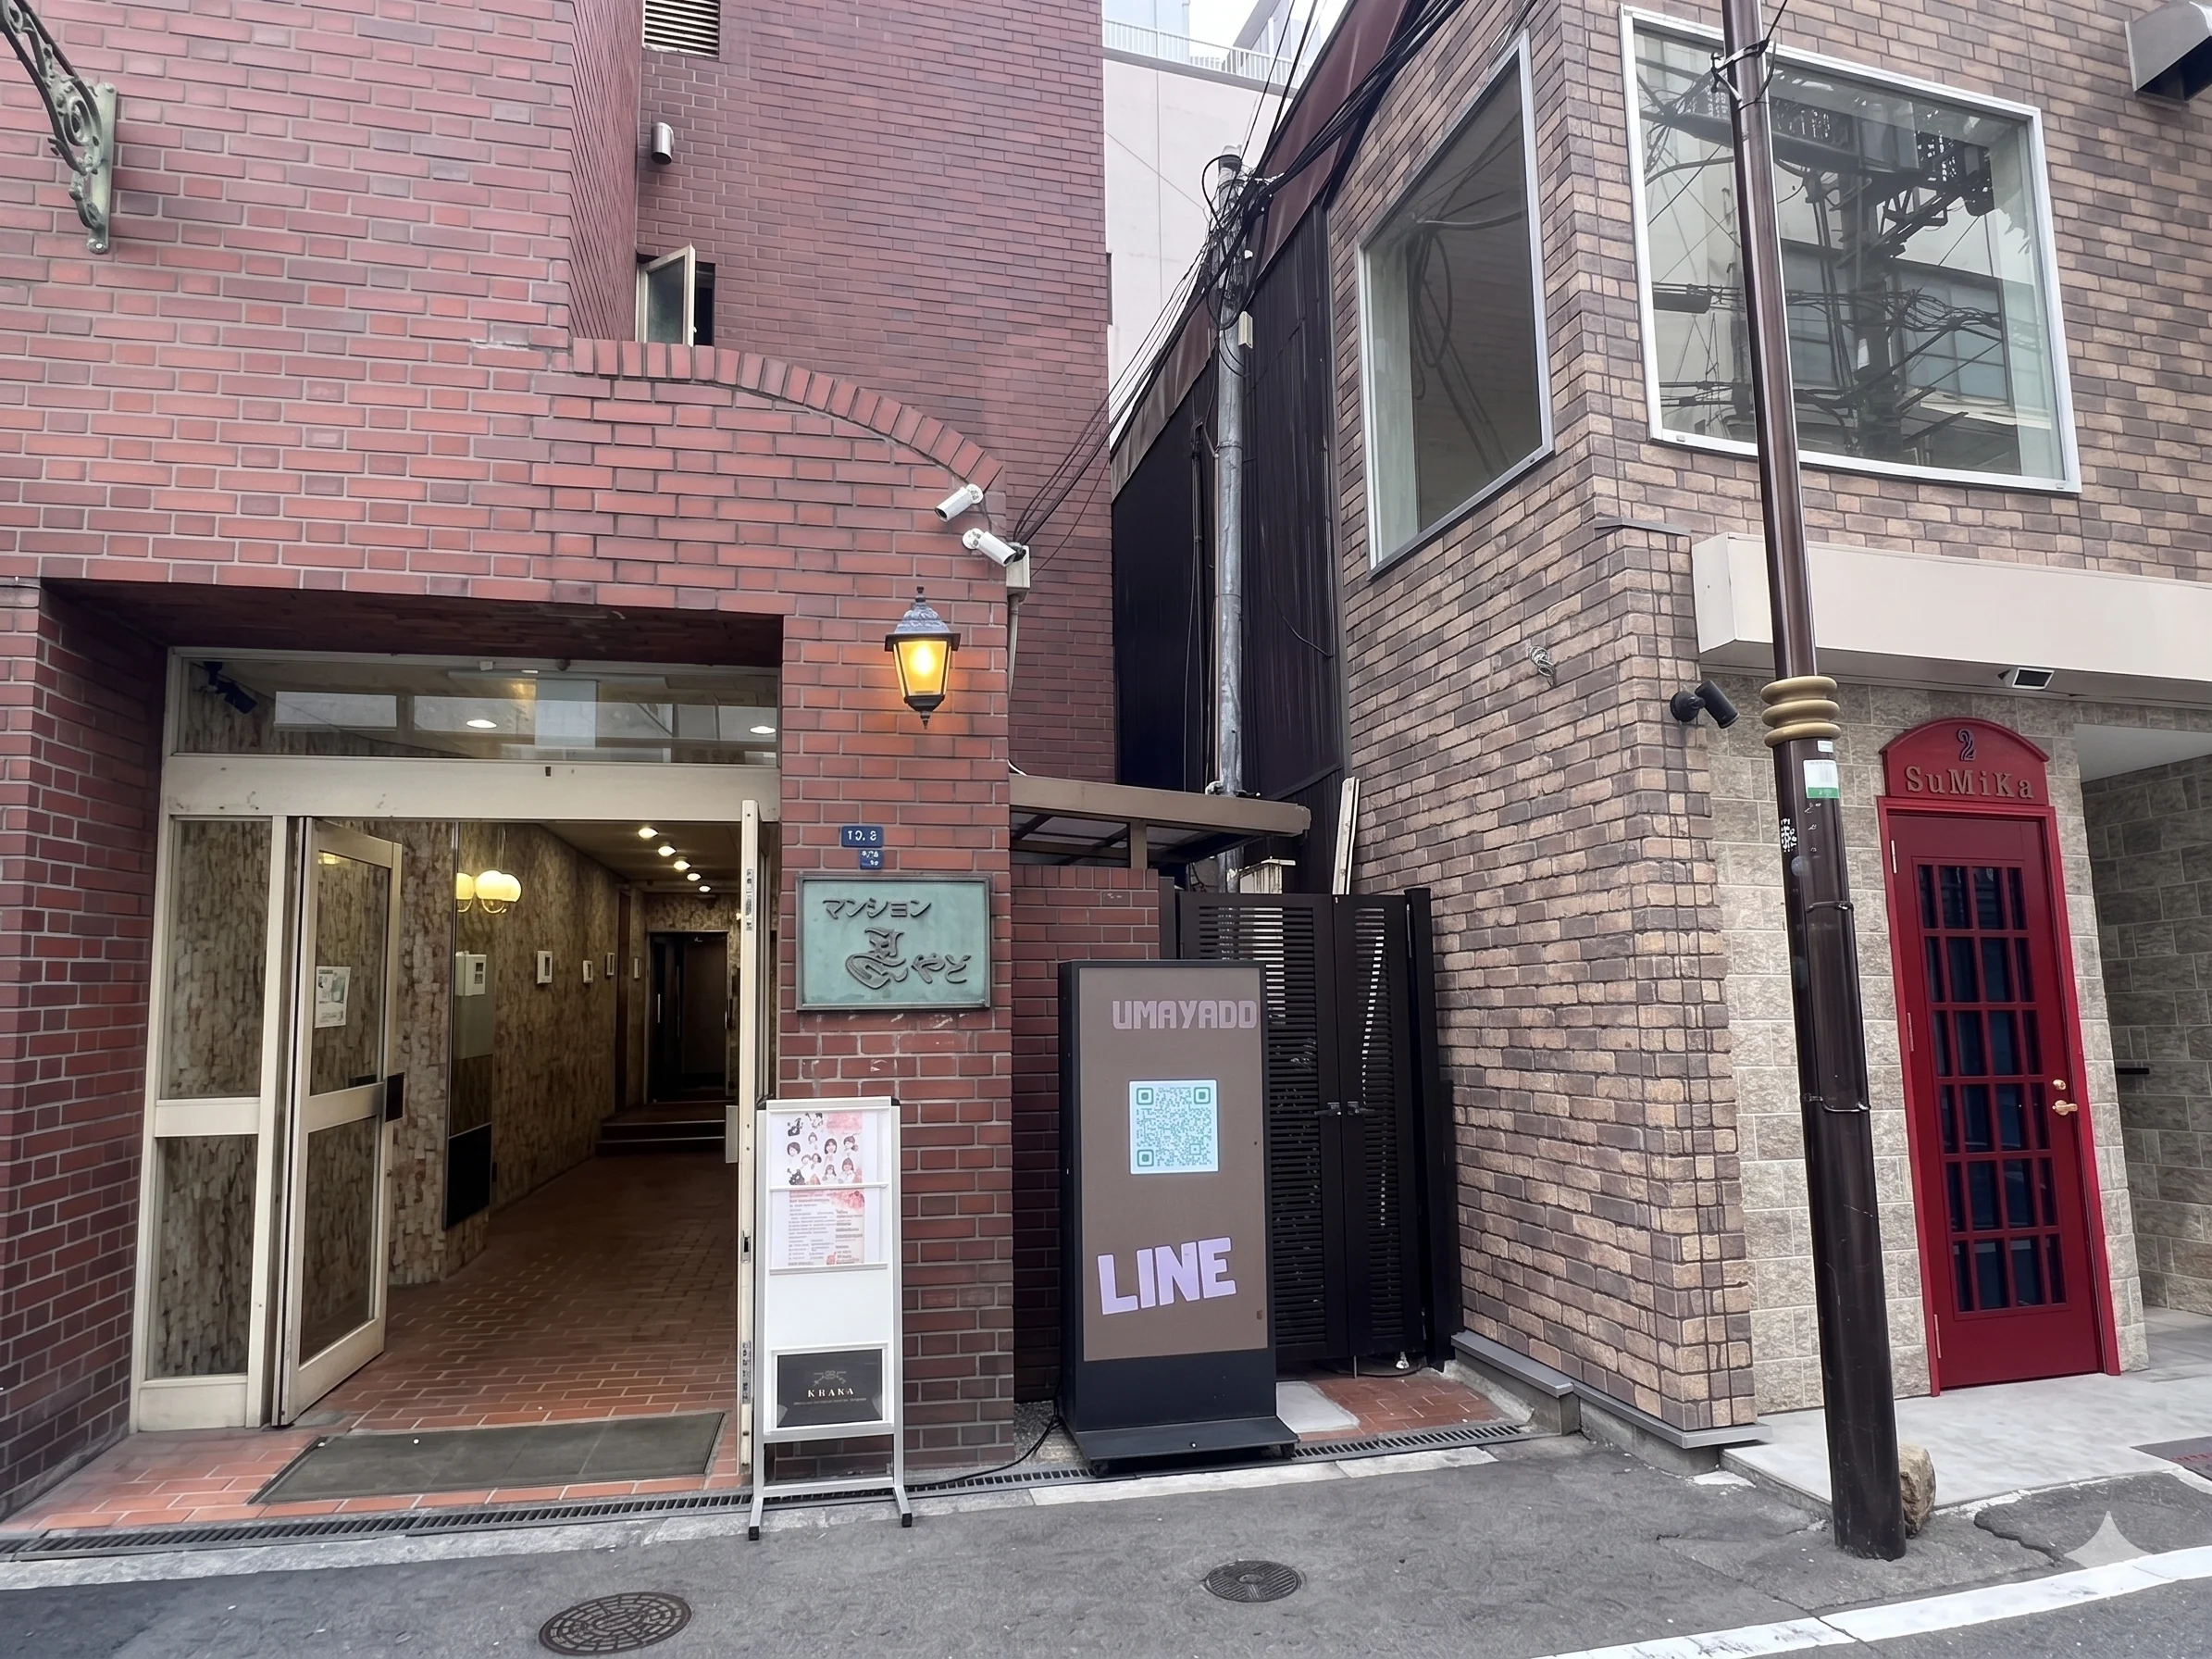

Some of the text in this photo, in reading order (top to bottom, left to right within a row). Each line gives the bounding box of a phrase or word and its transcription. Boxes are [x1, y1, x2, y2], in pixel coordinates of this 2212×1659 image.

[1905, 766, 2034, 799] SuMiKa
[822, 897, 932, 920] マンション
[1097, 1237, 1236, 1316] LINE
